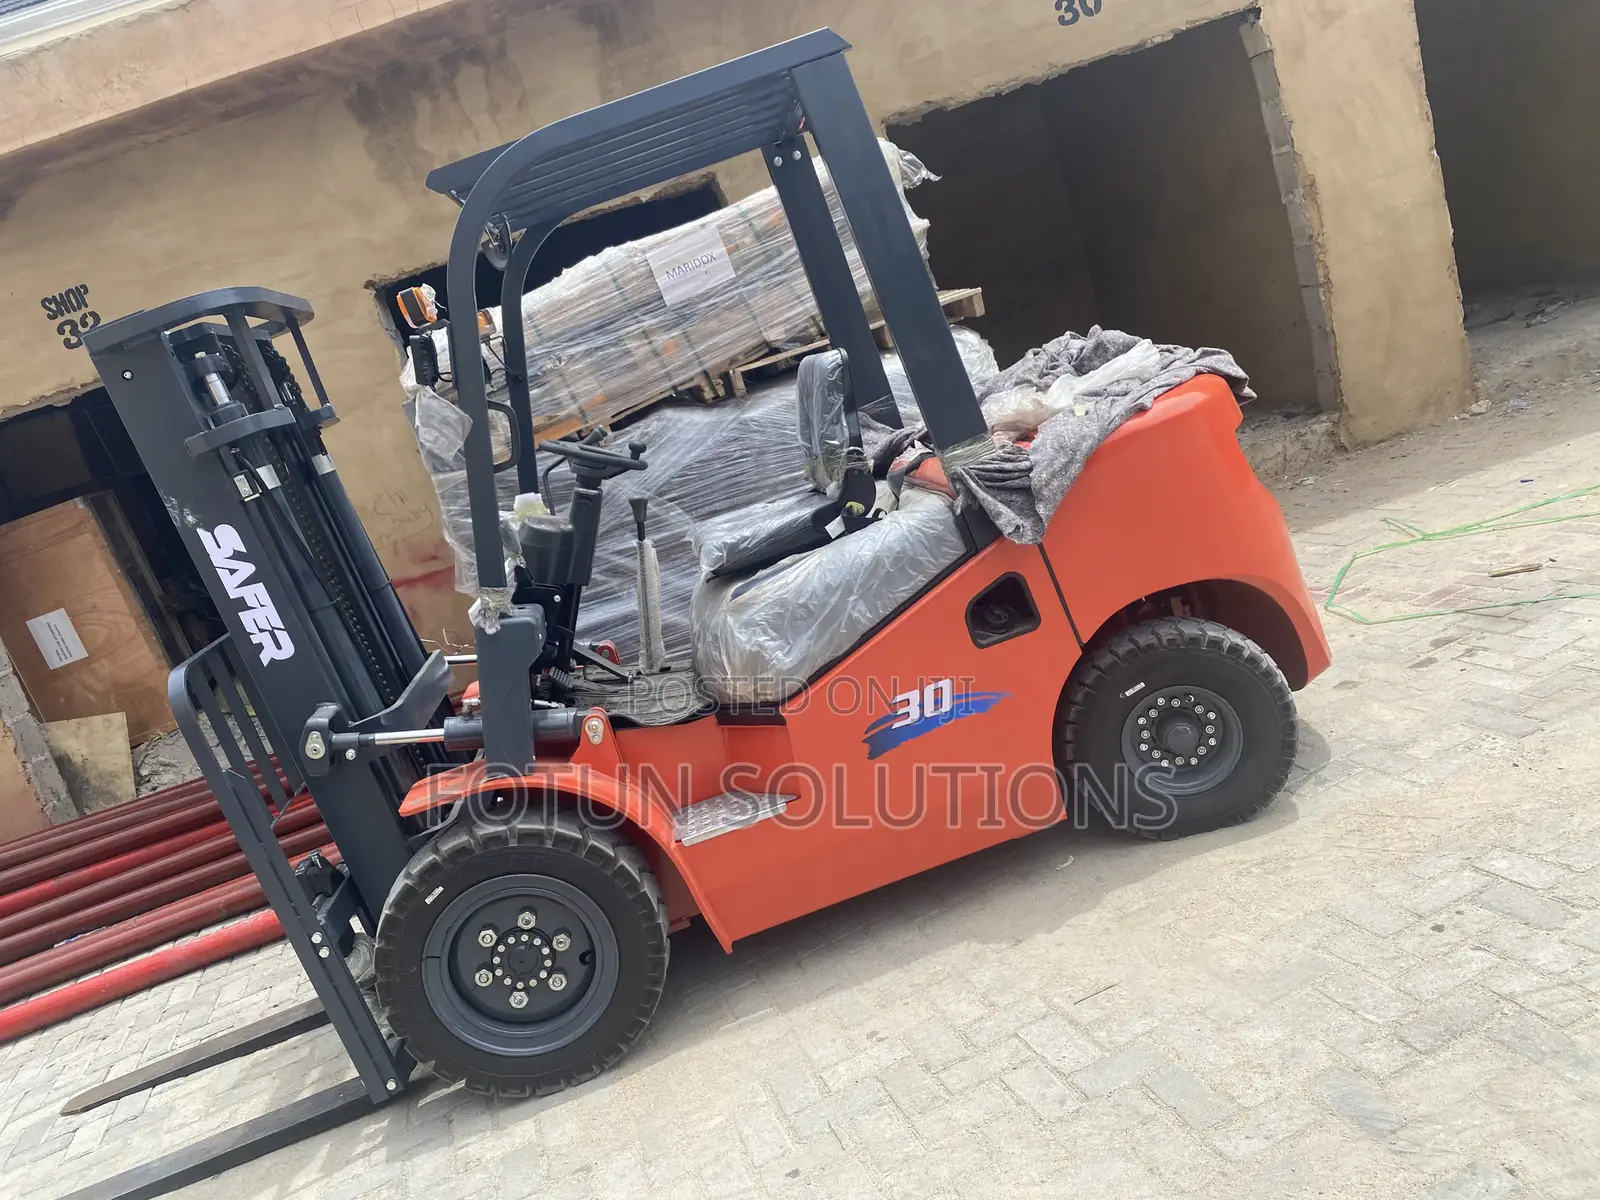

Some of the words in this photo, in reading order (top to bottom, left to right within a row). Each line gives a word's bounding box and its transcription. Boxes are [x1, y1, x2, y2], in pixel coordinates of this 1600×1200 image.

[1054, 0, 1102, 26] 30
[665, 252, 717, 279] MARIDOX
[40, 284, 89, 320] SHOP
[196, 524, 295, 668] SAFER
[890, 678, 954, 730] 30
